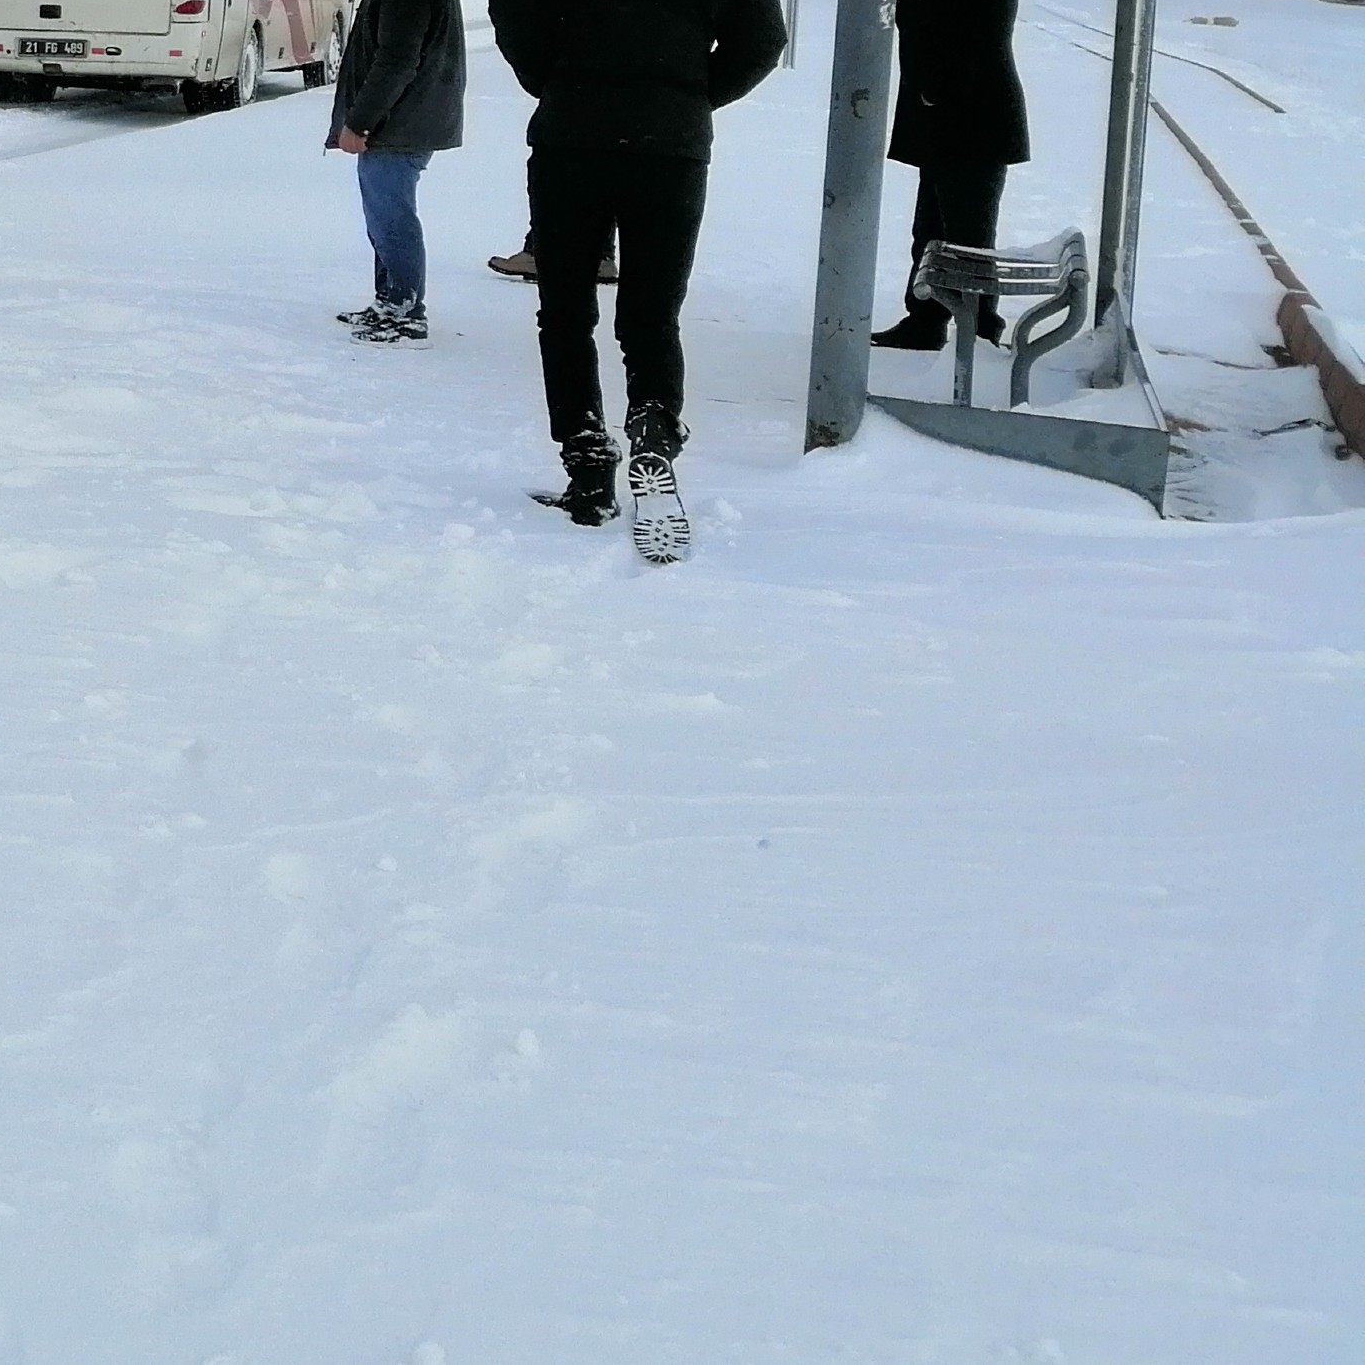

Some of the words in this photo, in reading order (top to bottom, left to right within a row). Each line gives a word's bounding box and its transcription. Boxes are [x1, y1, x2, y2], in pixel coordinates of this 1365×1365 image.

[26, 42, 38, 53] 21
[45, 42, 58, 53] FG
[64, 42, 83, 54] 489
